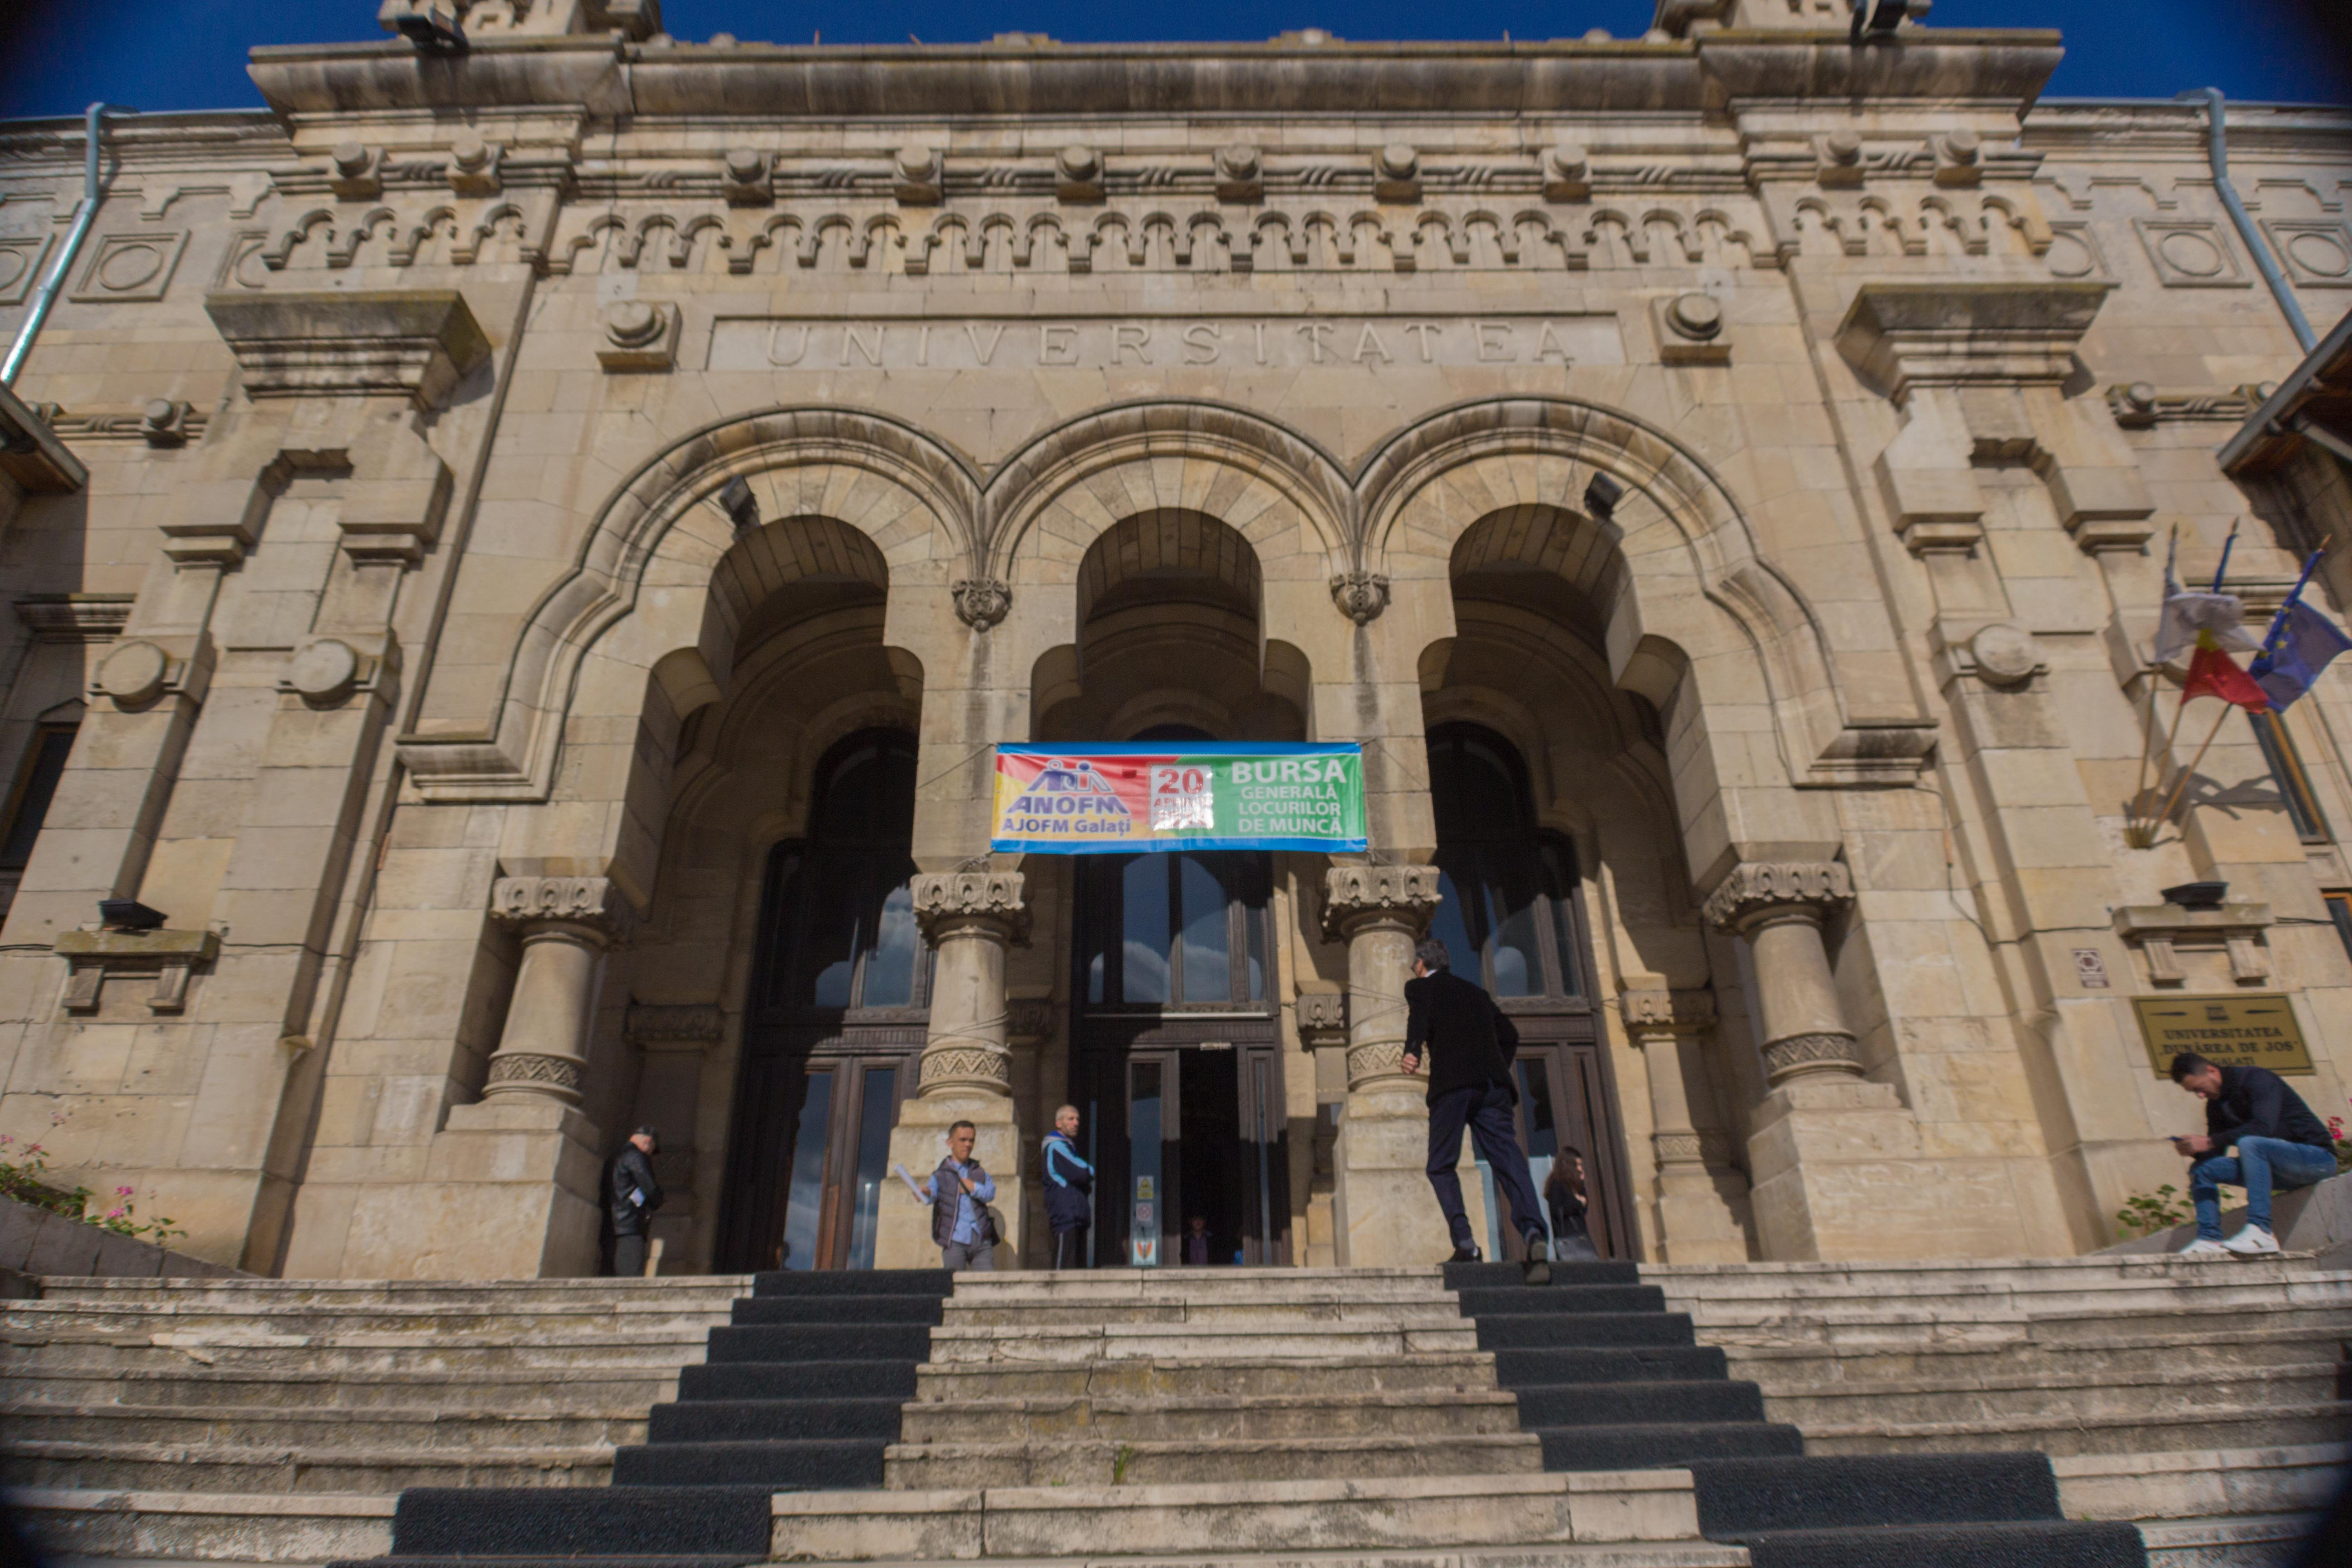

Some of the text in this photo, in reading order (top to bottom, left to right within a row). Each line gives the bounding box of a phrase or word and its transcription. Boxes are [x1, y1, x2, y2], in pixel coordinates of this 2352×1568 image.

[766, 320, 1576, 368] UNIVERSITATEA
[1231, 759, 1347, 784] BURSA
[1158, 768, 1204, 794] 20
[1241, 784, 1338, 799] GENERALĂ
[1005, 795, 1131, 815] ANOFM
[1239, 801, 1342, 816] LOCURILOR
[1001, 818, 1069, 833] AJOFM
[1239, 817, 1343, 834] DE MUNCĂ
[2163, 1027, 2283, 1039] UNIVERSITATEA
[2238, 1042, 2259, 1052] DE
